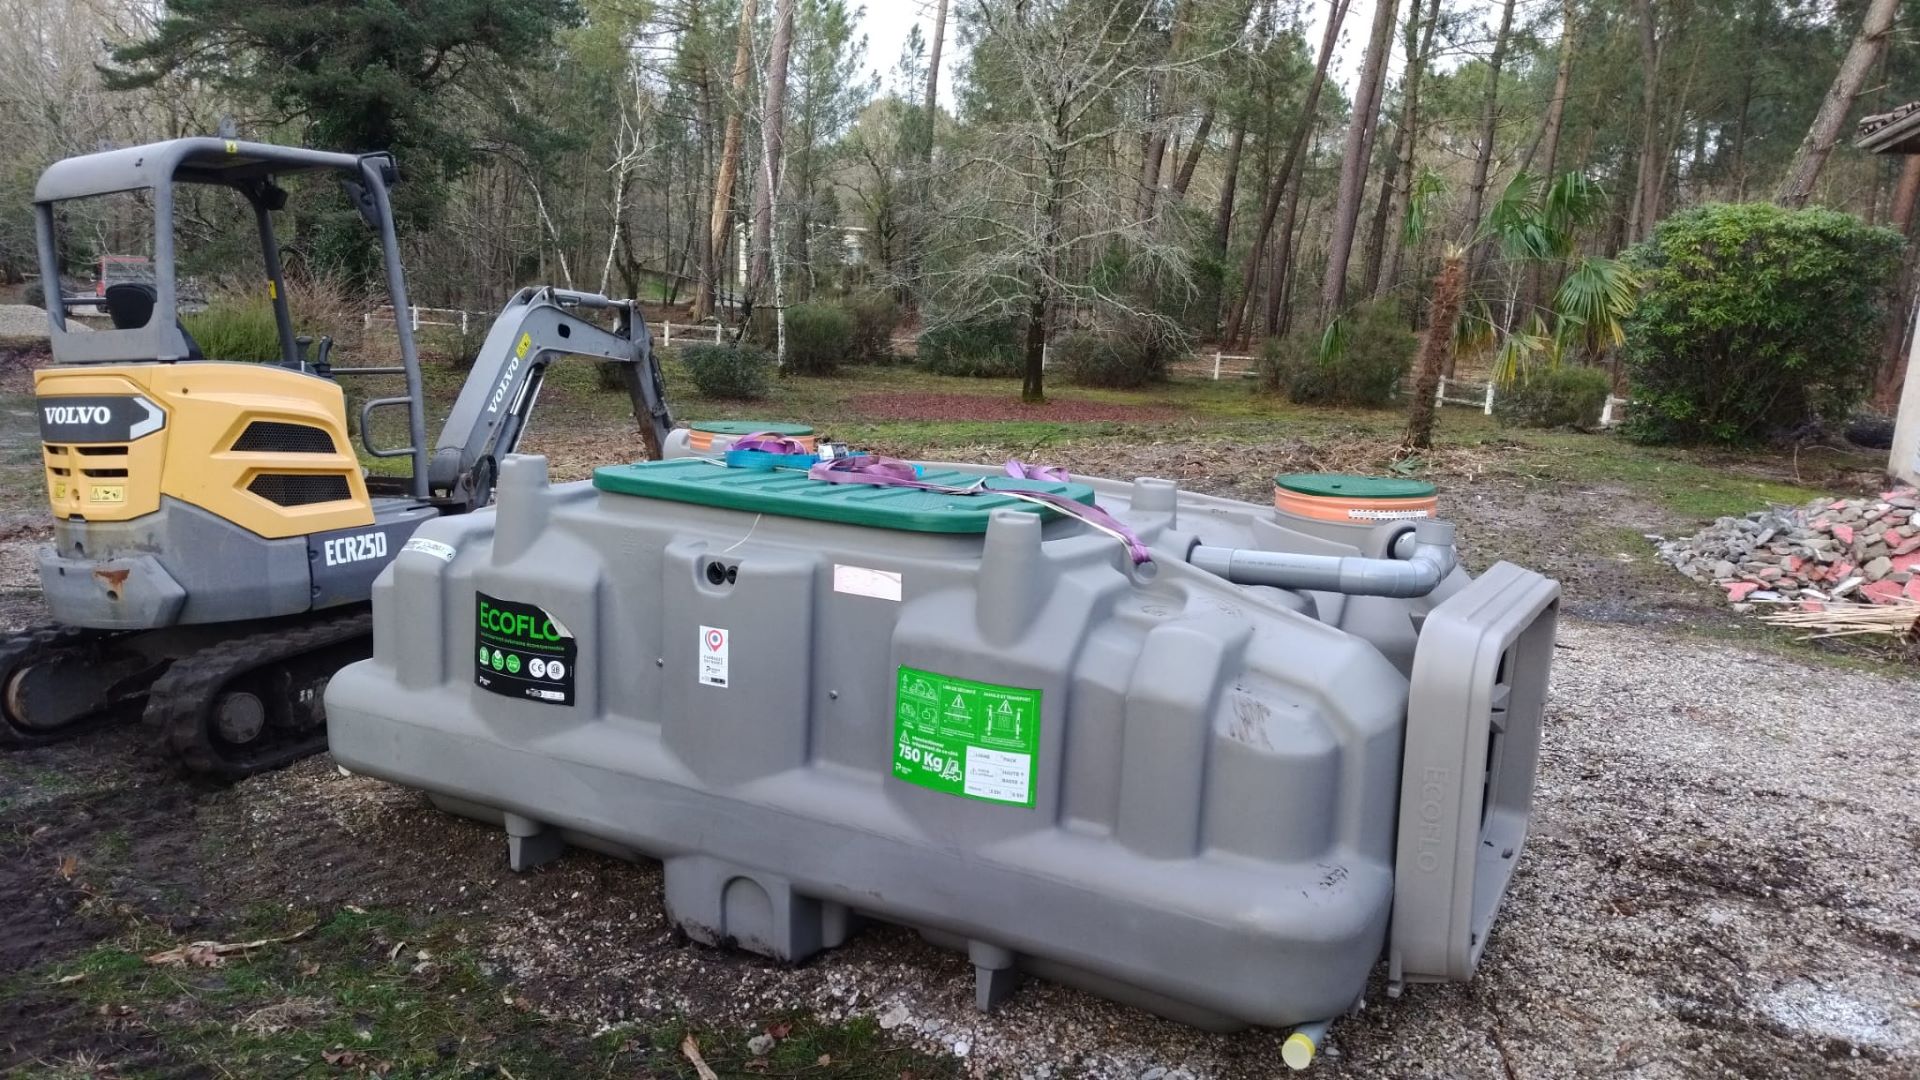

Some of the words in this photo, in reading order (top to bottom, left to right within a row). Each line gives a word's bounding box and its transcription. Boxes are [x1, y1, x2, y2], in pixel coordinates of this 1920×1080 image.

[487, 356, 519, 413] VOLVO
[44, 406, 111, 424] VOLVO
[324, 531, 388, 566] ECR25D
[898, 743, 921, 763] 750
[923, 751, 943, 772] Kg
[1417, 766, 1449, 873] ECOFLO
